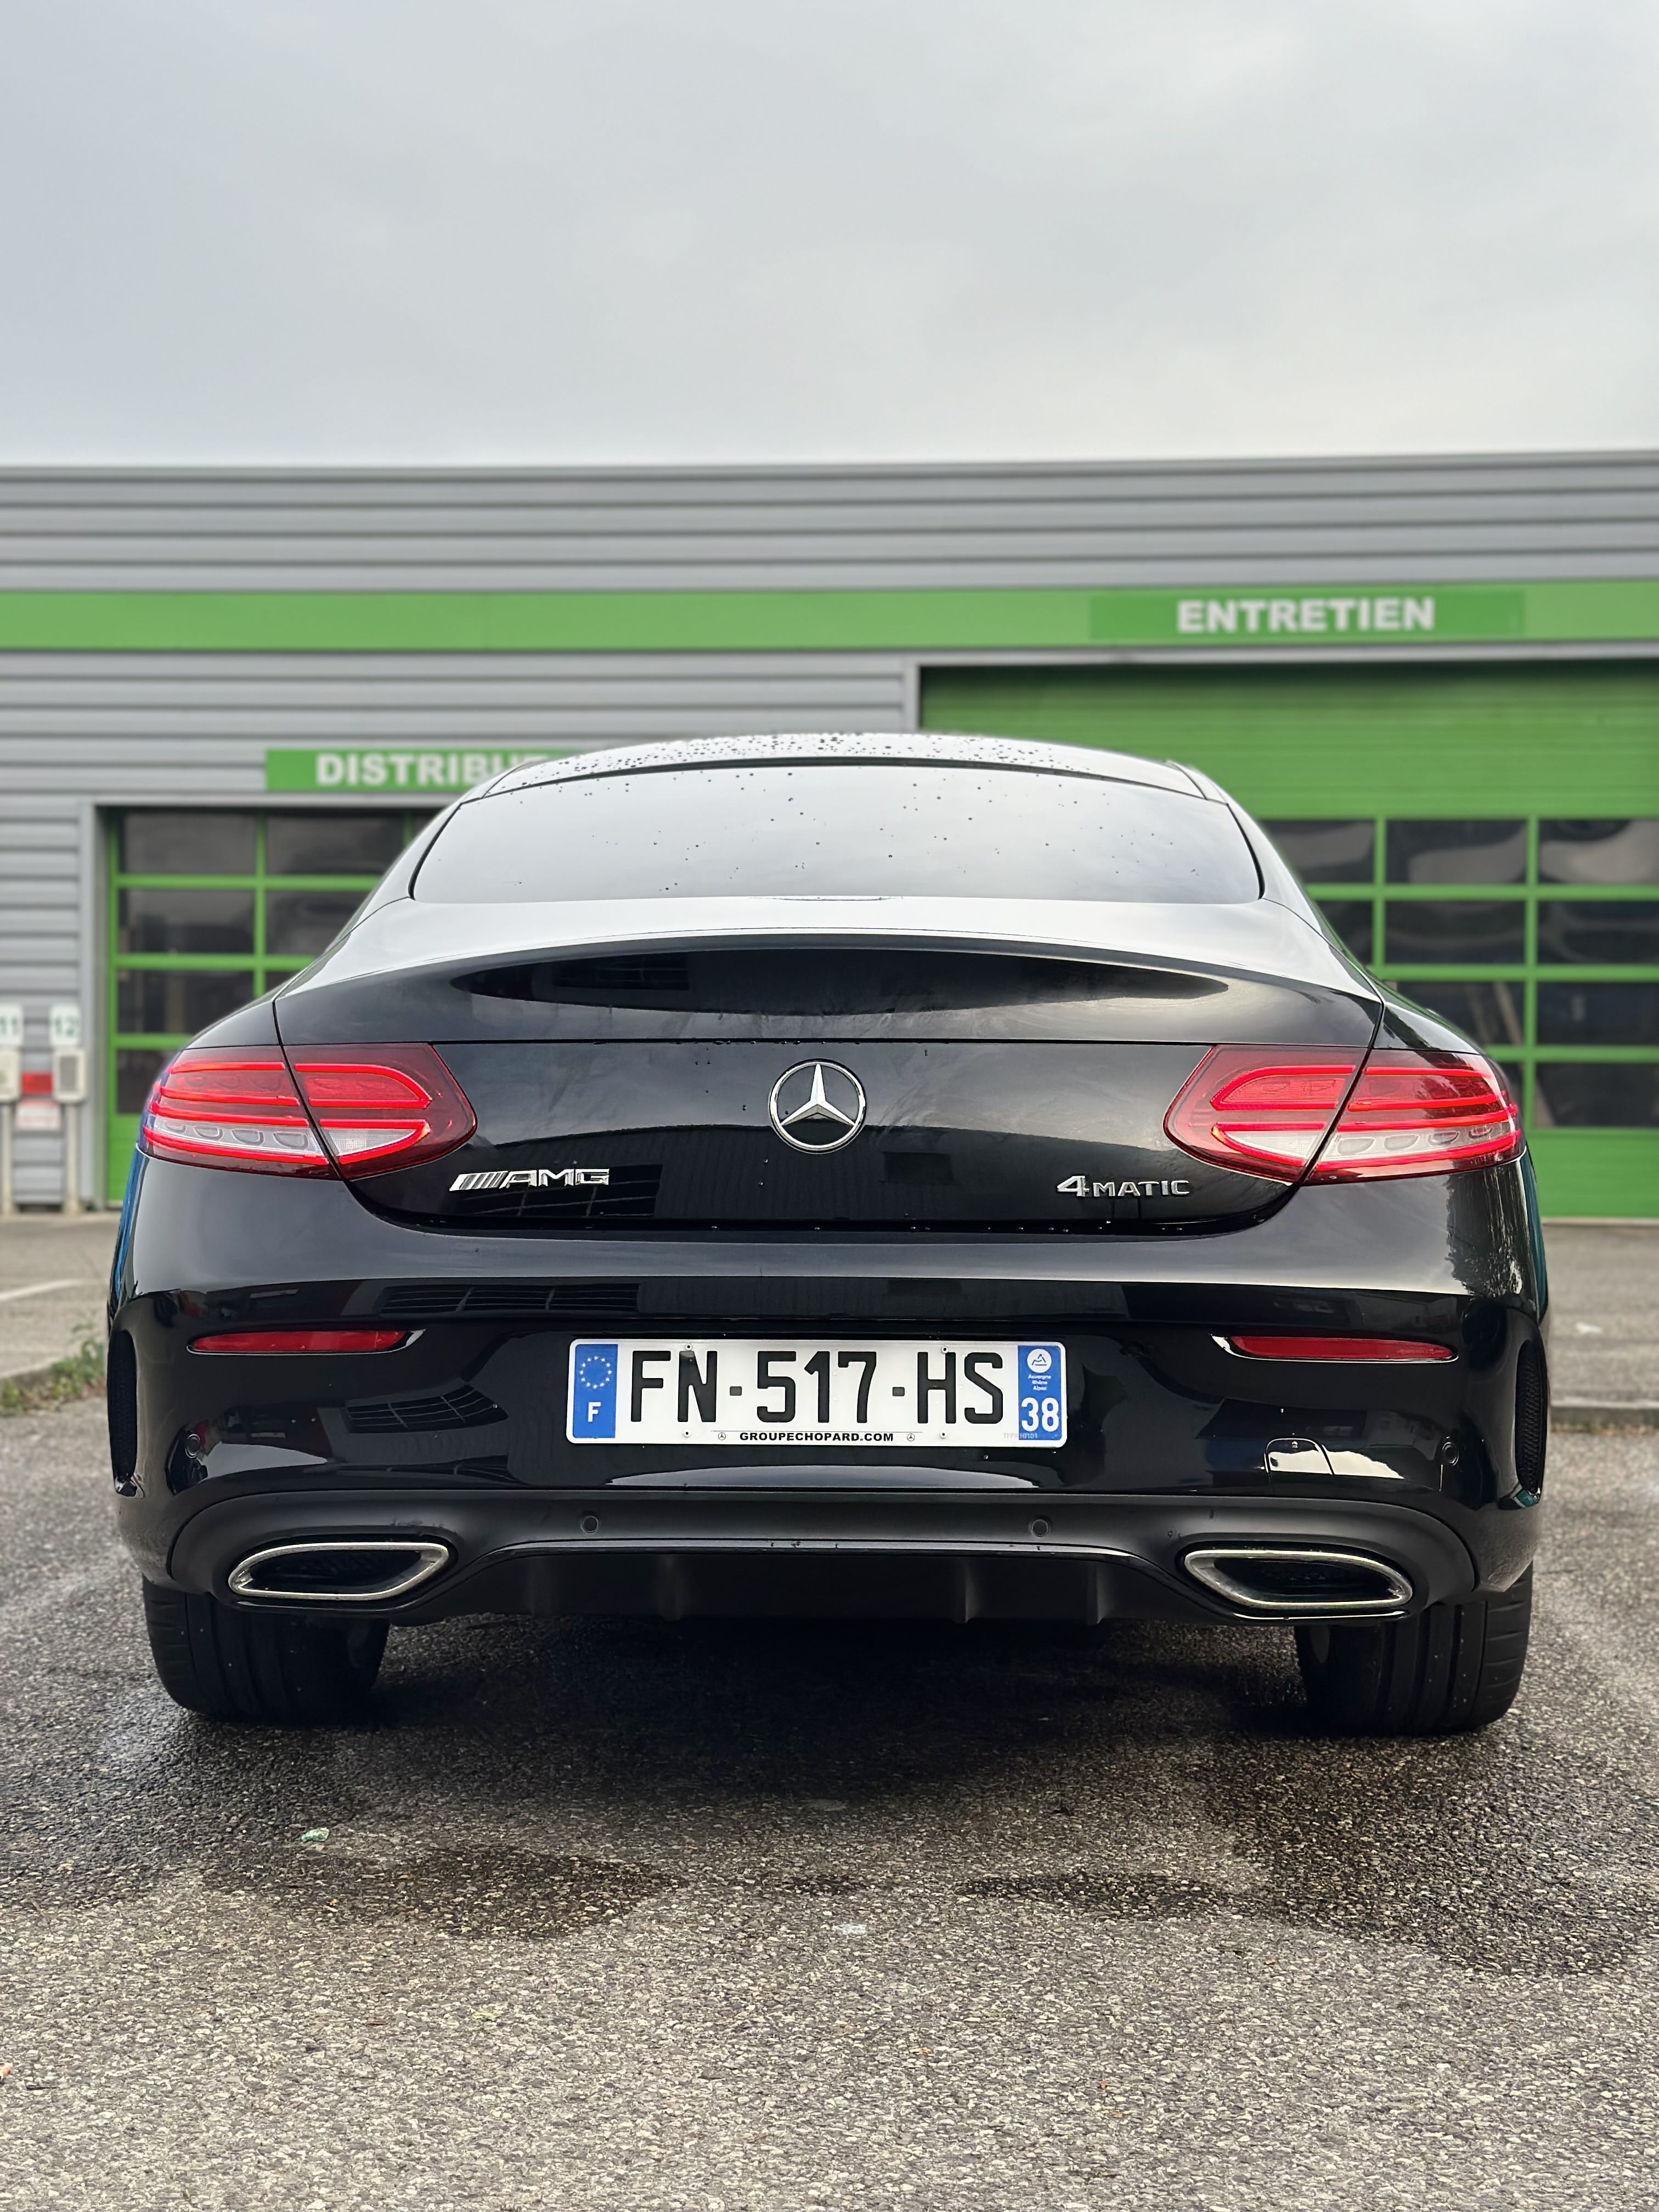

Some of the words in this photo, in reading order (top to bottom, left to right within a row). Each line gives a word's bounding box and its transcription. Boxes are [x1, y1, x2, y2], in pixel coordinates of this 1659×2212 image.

[1178, 598, 1435, 633] ENTRETIEN
[317, 753, 546, 785] DISTRIBU
[51, 1015, 79, 1036] 12
[1057, 1175, 1190, 1197] 4MATIC
[631, 1351, 1003, 1424] FN-517-HS
[588, 1402, 601, 1423] F
[1021, 1397, 1059, 1431] 38
[740, 1432, 894, 1442] GROUPECHOPARD.COM
